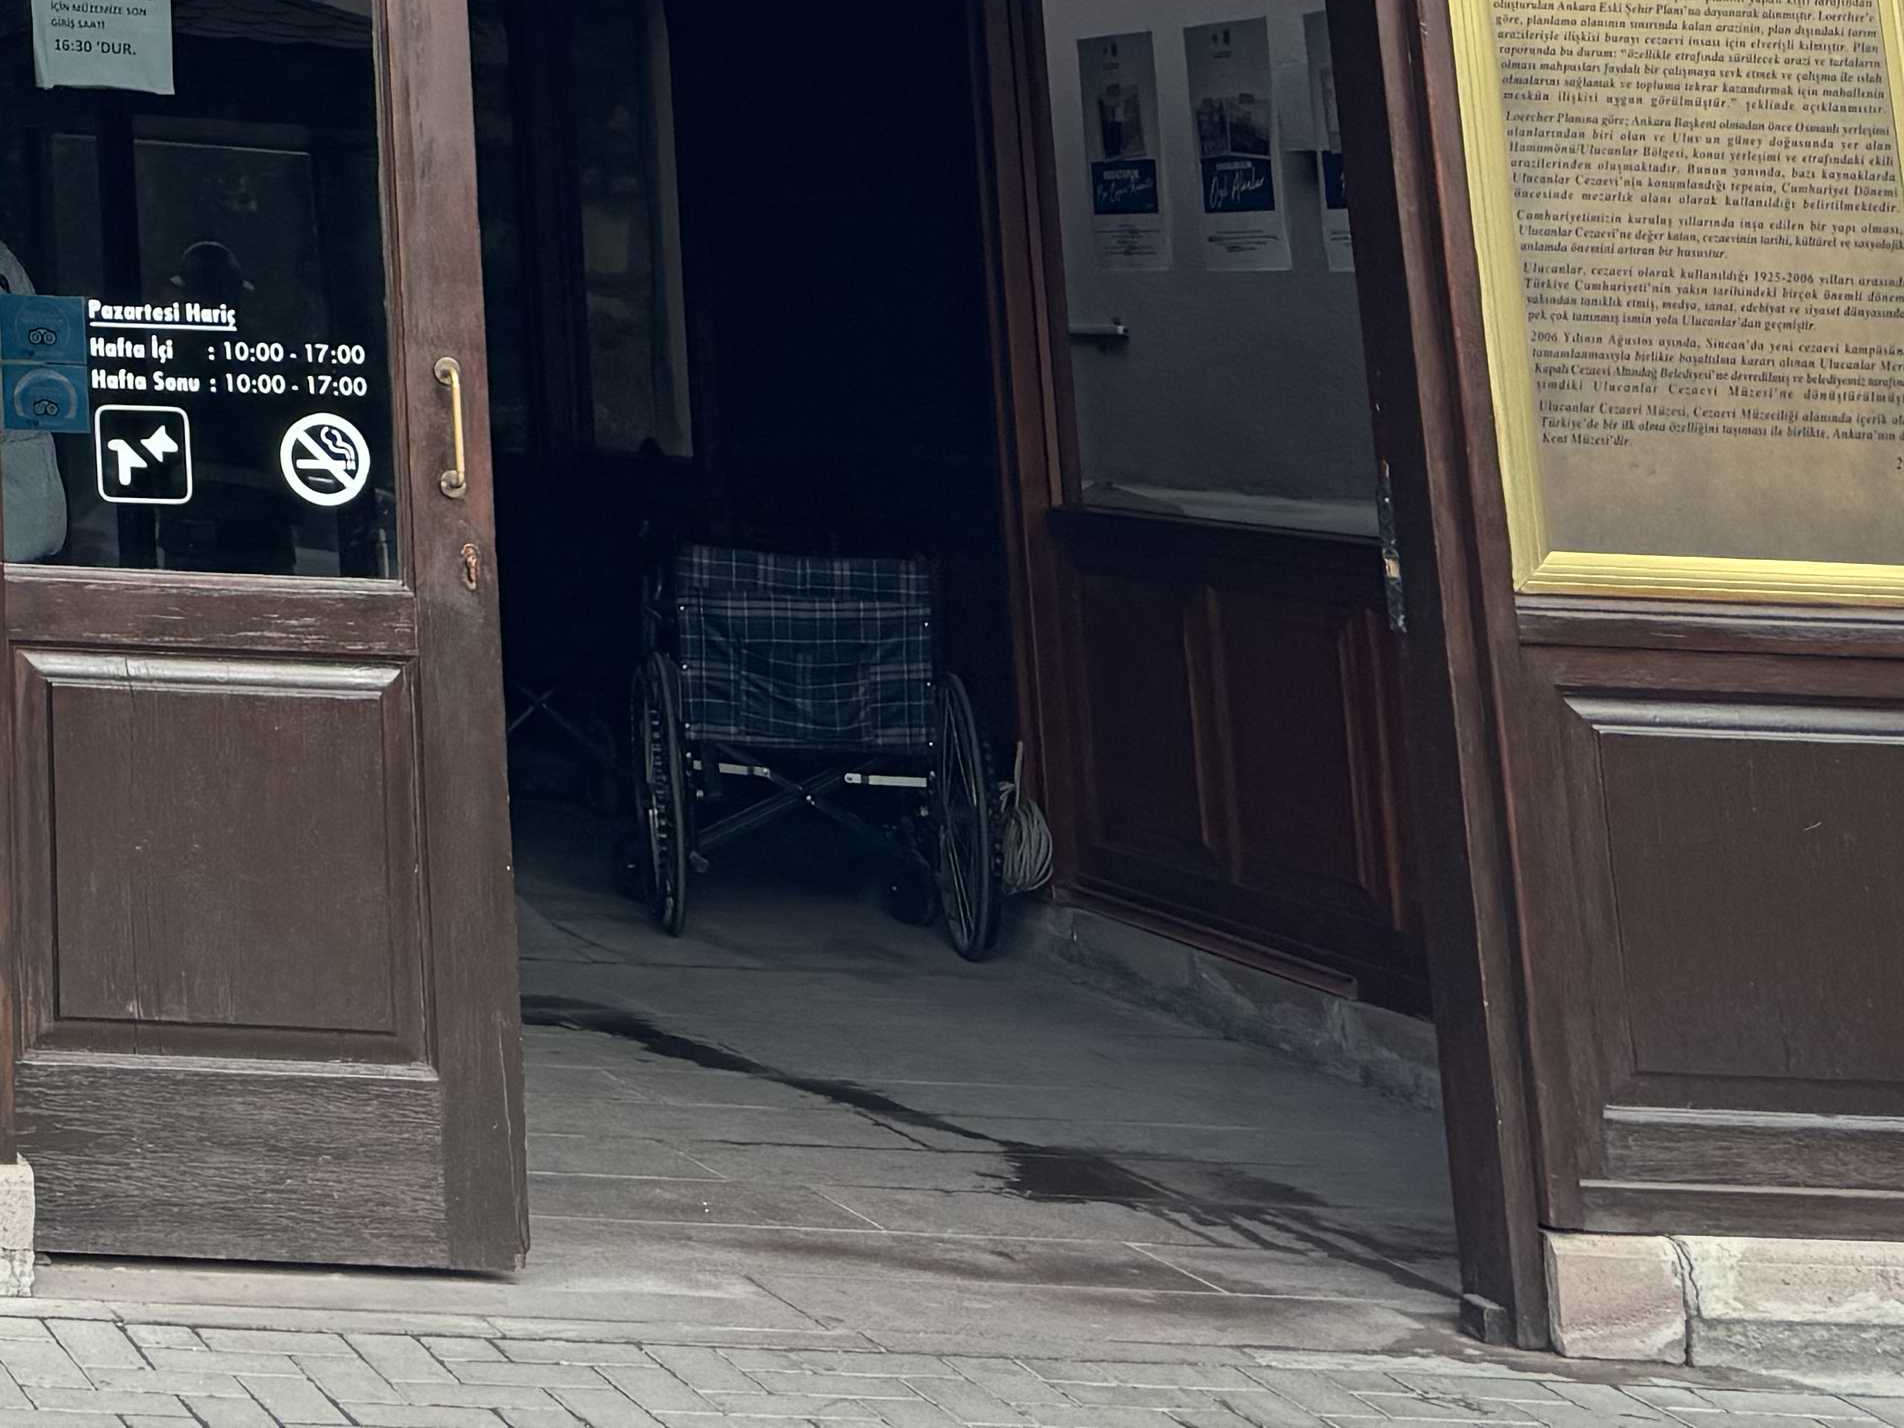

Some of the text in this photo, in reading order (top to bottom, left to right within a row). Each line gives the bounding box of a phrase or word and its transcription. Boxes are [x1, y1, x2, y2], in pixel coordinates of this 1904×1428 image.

[1681, 21, 1712, 32] kalan
[1768, 24, 1791, 36] plan
[55, 38, 92, 53] 16:30
[1809, 221, 1826, 231] bir
[88, 299, 236, 327] Pazartesi Hariç
[90, 337, 145, 358] Hafta
[151, 334, 173, 364] İçi
[223, 341, 284, 363] 10:00
[304, 343, 365, 365] 17:00
[91, 369, 147, 390] Hafta
[153, 370, 200, 392] Sonu
[225, 373, 286, 395] 10:00
[306, 375, 367, 396] 17:00
